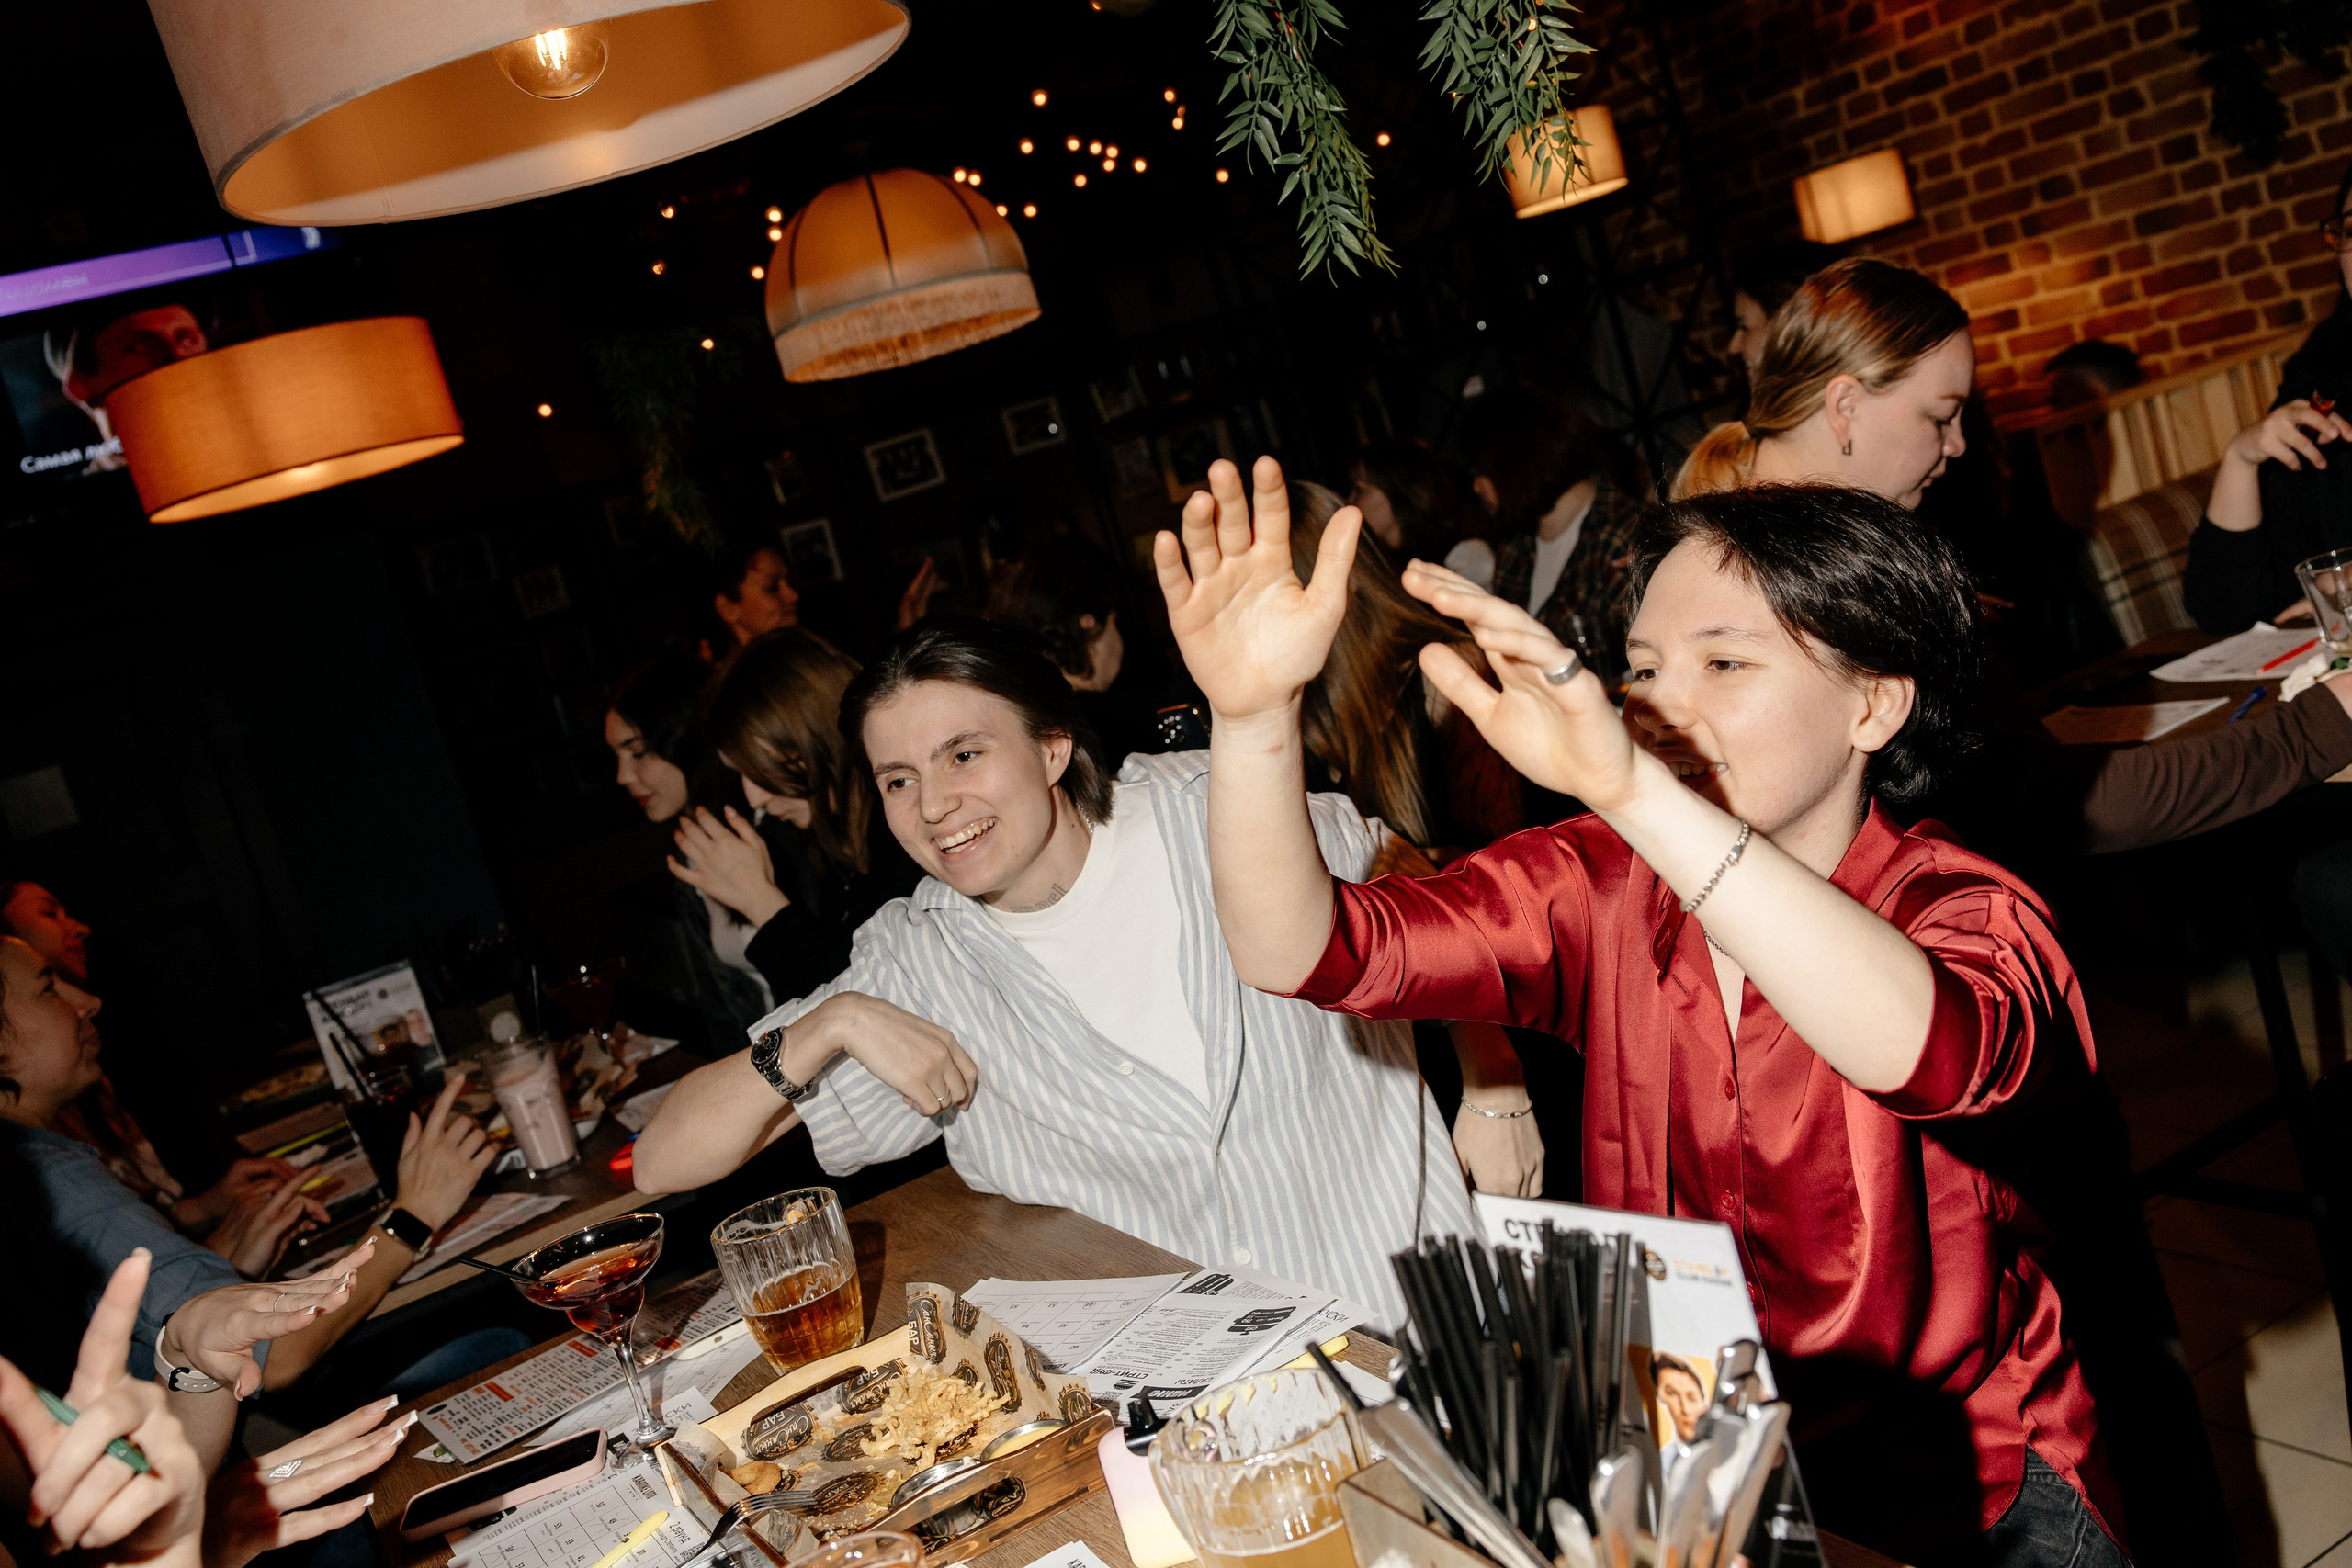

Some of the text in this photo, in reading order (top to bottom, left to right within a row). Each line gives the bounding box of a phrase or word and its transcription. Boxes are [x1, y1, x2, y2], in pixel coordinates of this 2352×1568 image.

[20, 448, 83, 474] Самая
[1089, 1368, 1149, 1379] СТРИТ-ФУД
[1148, 1389, 1193, 1398] МЕНЮ
[762, 1411, 786, 1430] БАР
